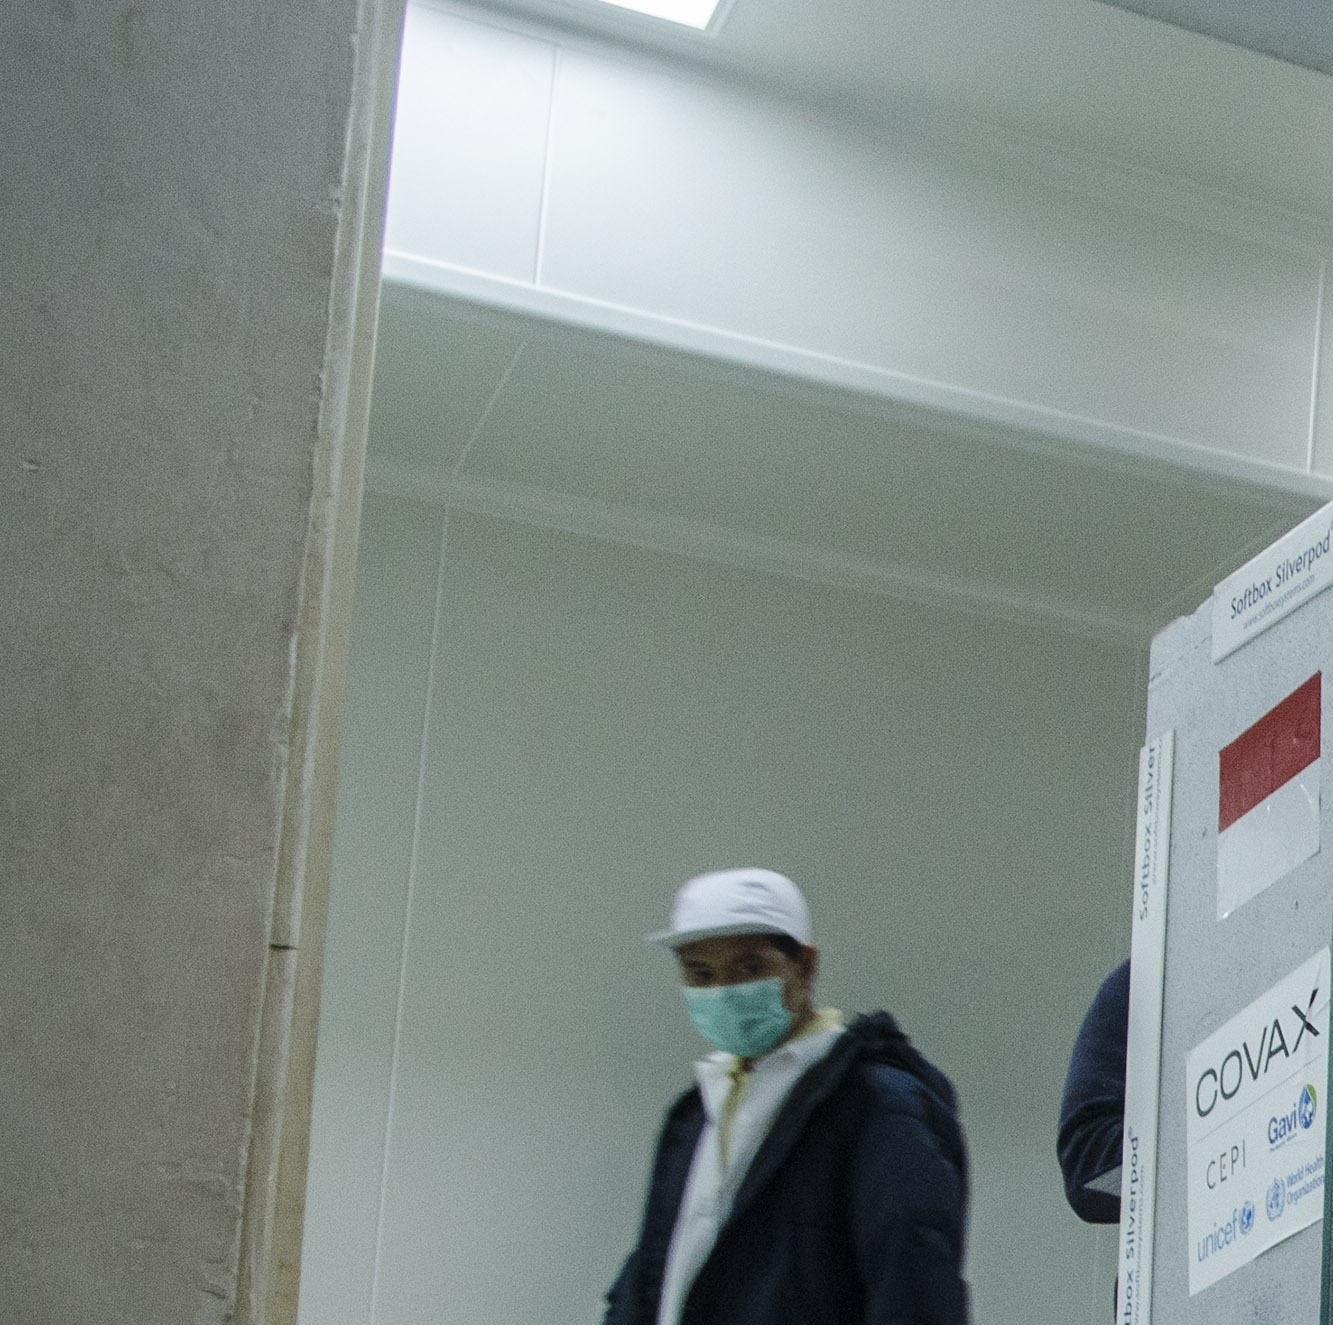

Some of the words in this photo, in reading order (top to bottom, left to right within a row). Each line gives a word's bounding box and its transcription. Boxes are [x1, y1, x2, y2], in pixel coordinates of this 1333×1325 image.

[1230, 576, 1272, 620] Softbox
[1139, 826, 1151, 921] Softbox
[1195, 988, 1320, 1118] COVAX
[1267, 1102, 1297, 1145] Gavi
[1206, 1139, 1246, 1190] CEPI
[1196, 1207, 1238, 1262] unicef
